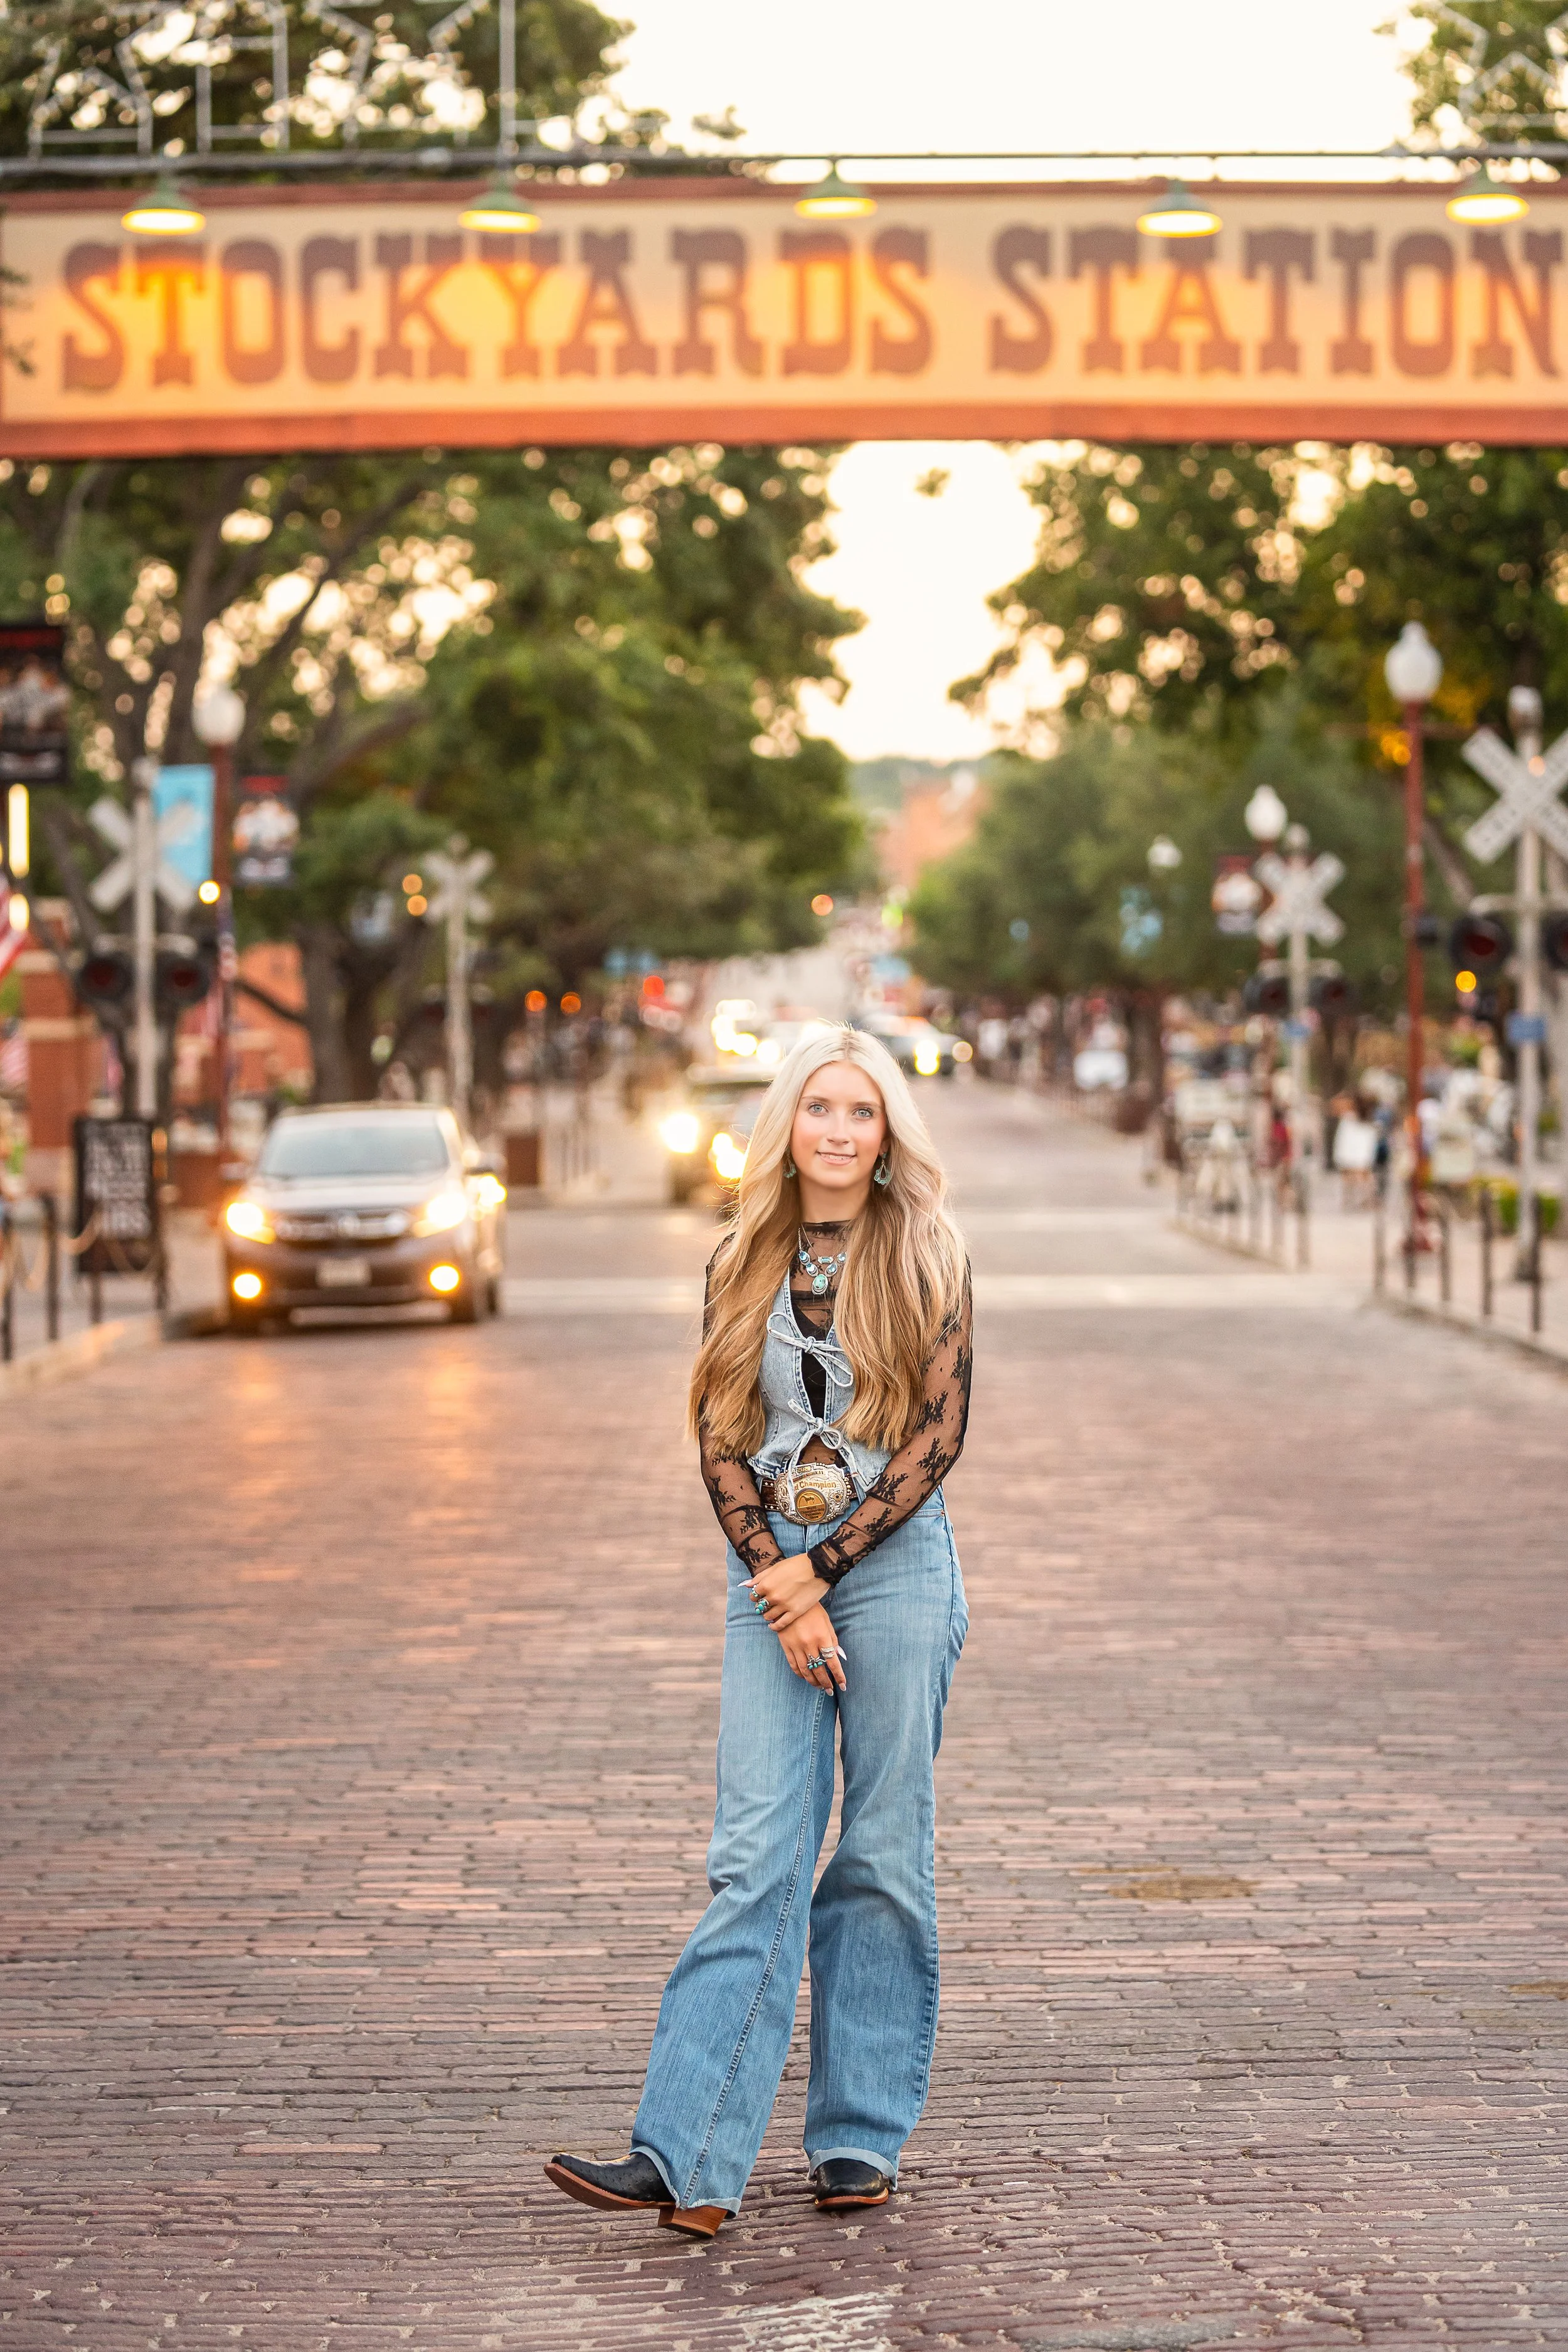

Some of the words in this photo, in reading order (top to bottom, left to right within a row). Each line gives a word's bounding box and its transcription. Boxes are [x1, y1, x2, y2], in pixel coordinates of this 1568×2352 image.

[61, 225, 935, 391] STOCKYARDS
[987, 223, 1564, 379] STATION
[800, 1481, 837, 1490] Champion
